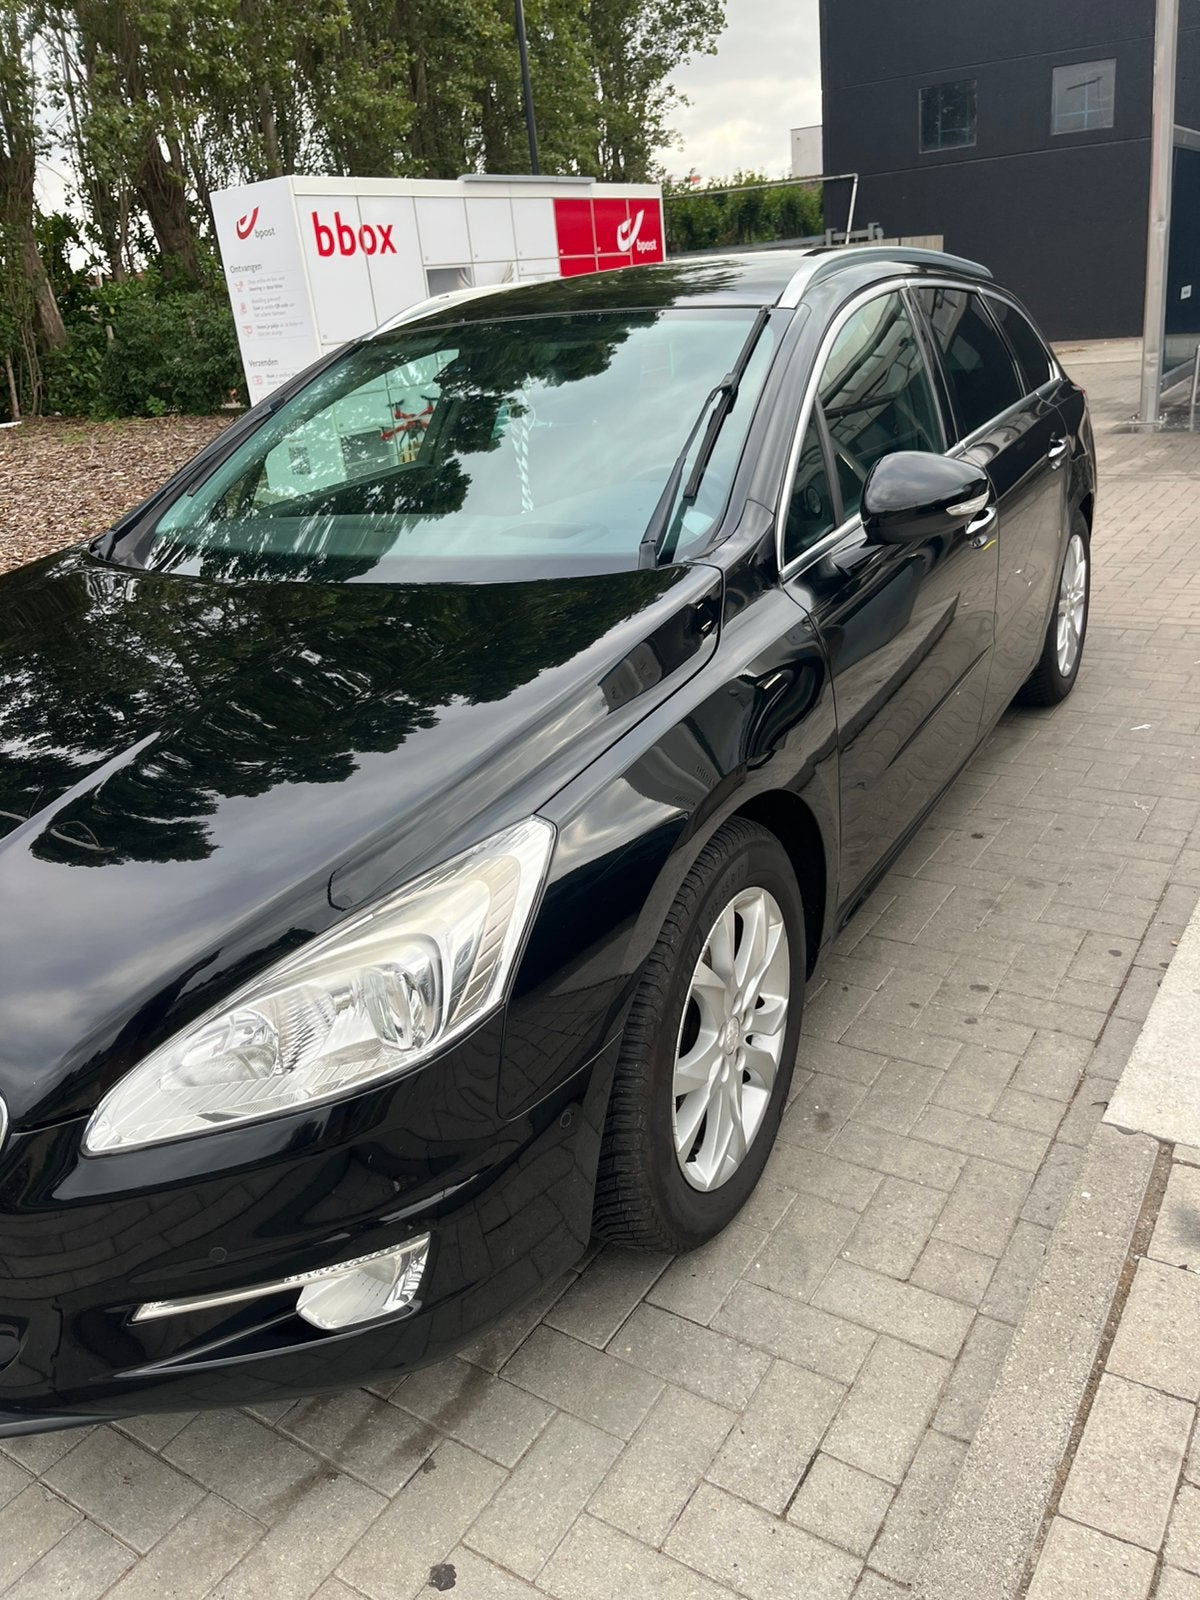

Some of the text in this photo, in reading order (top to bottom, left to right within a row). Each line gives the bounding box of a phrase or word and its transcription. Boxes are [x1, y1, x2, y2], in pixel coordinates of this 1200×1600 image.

[255, 227, 275, 240] bpost
[311, 211, 398, 257] bbox
[636, 238, 657, 254] bpost
[230, 264, 262, 274] Ontvangen
[248, 357, 279, 368] Verzenden
